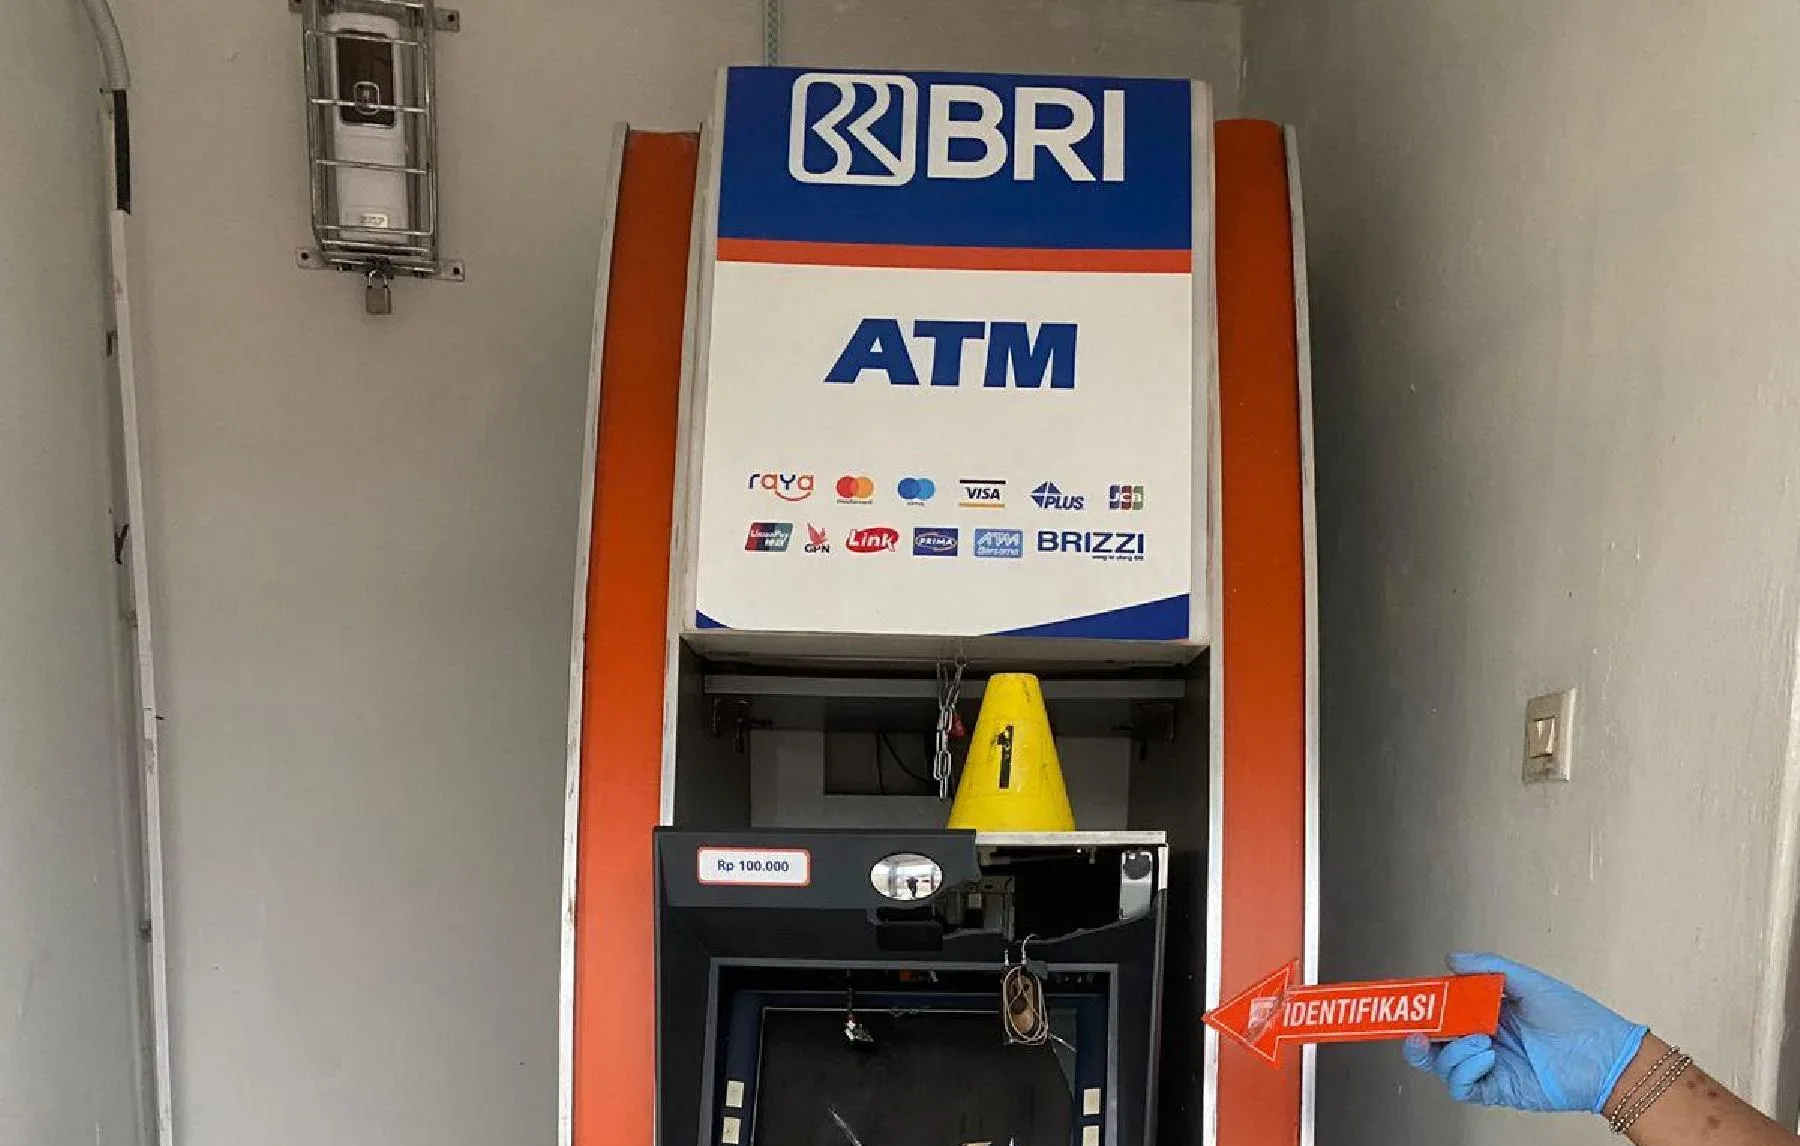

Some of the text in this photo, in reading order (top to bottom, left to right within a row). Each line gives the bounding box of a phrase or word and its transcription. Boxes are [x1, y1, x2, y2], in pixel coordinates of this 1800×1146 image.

[927, 84, 1126, 182] BRI
[824, 318, 1078, 389] ATM
[748, 474, 814, 492] raya
[965, 486, 1001, 500] VISA
[1044, 495, 1084, 510] PLUS
[804, 543, 830, 554] GPN
[849, 529, 894, 549] Link
[919, 537, 953, 546] PRIMA
[1037, 531, 1144, 554] BRIZZI
[996, 724, 1014, 789] 1
[717, 860, 789, 873] Rp 100.000
[1283, 993, 1436, 1027] IDENTIFIKASI
